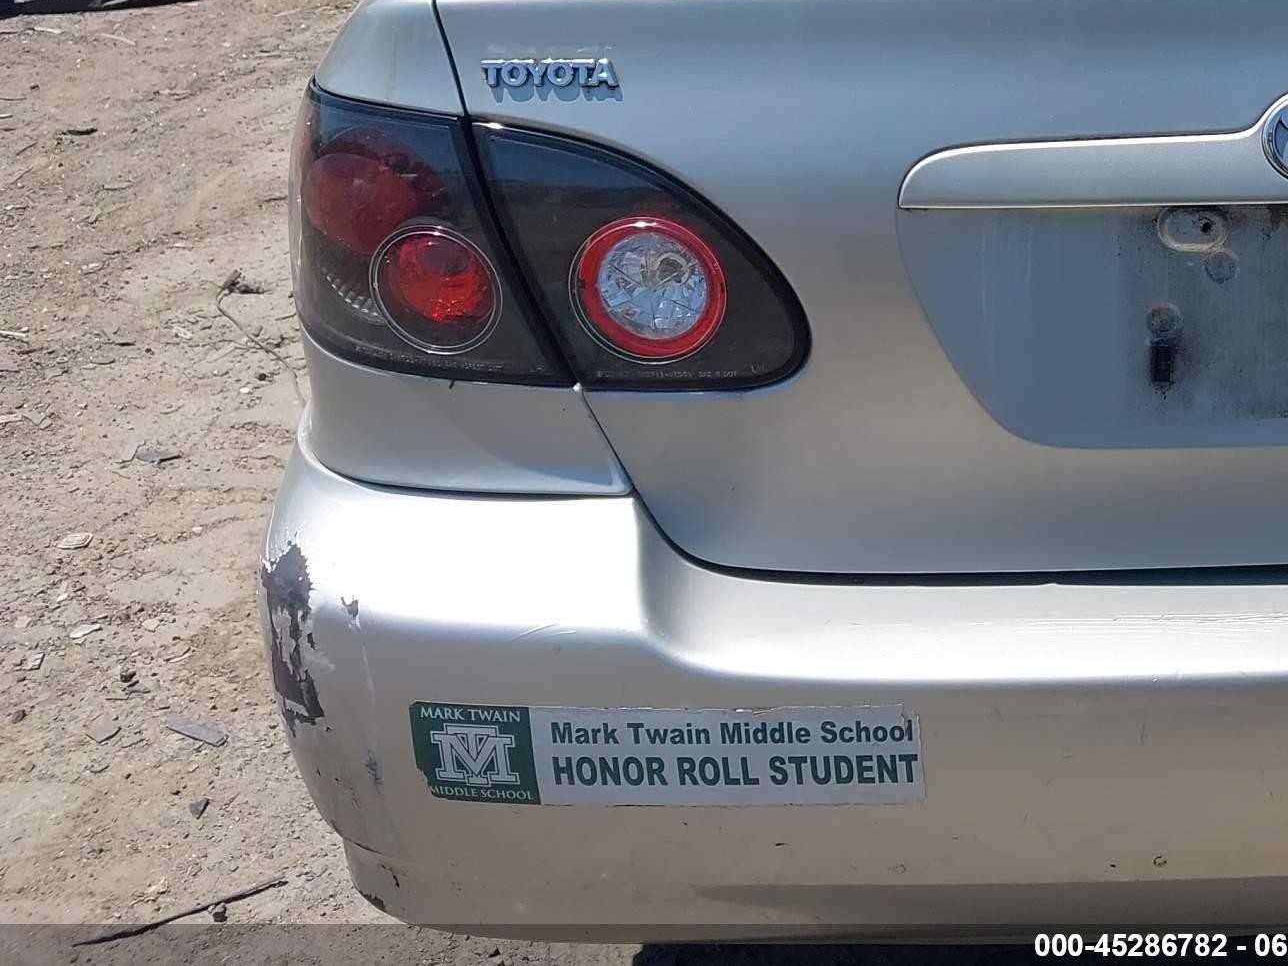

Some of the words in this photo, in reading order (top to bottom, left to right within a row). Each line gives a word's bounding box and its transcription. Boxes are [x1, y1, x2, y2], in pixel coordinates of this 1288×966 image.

[480, 57, 619, 88] TOYOTA
[420, 705, 465, 721] MARK
[467, 708, 521, 723] TWAIN
[551, 721, 619, 745] Mark
[627, 722, 711, 745] Twain
[720, 721, 811, 745] Middle
[820, 719, 913, 744] School
[552, 756, 668, 786] HONOR
[676, 756, 760, 786] ROLL
[768, 753, 918, 785] STUDENT
[430, 785, 478, 798] MIDDLE
[480, 789, 536, 800] SCHOOL
